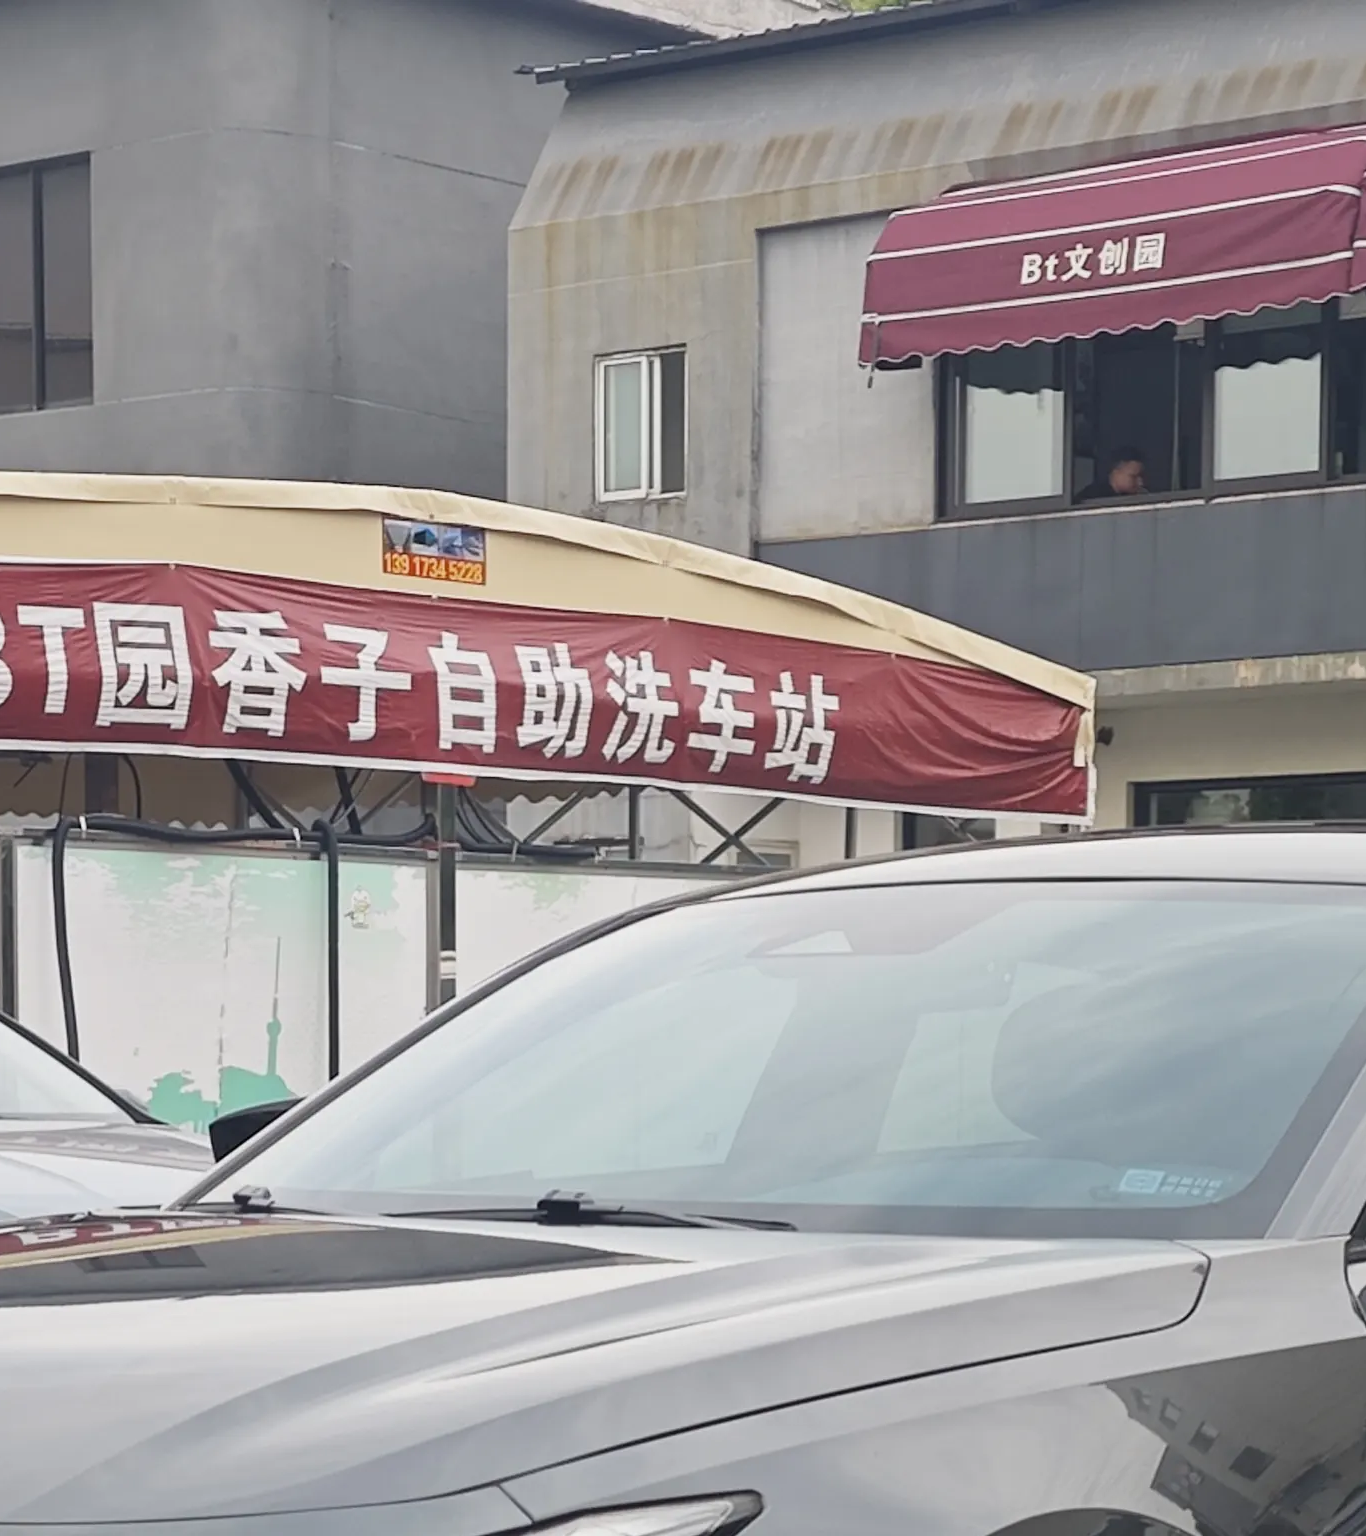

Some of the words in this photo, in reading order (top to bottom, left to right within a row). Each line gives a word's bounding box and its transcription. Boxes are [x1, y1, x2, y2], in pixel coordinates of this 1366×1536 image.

[1020, 232, 1166, 285] Bt文创园
[384, 553, 410, 574] 139
[413, 556, 447, 579] 1734
[449, 560, 484, 583] 5228
